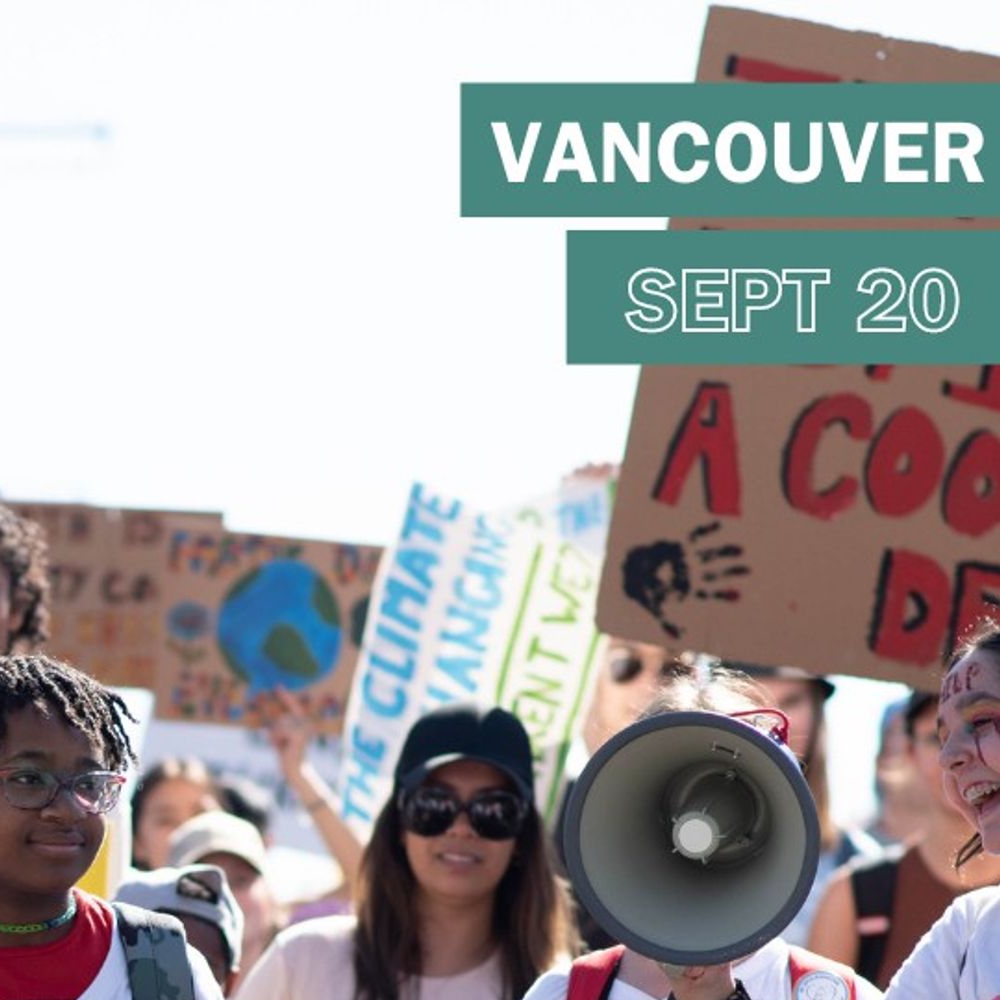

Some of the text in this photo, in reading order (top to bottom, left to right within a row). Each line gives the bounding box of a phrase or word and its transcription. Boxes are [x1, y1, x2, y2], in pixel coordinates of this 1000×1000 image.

[652, 381, 742, 519] A
[343, 482, 462, 822] THE CLIMATE
